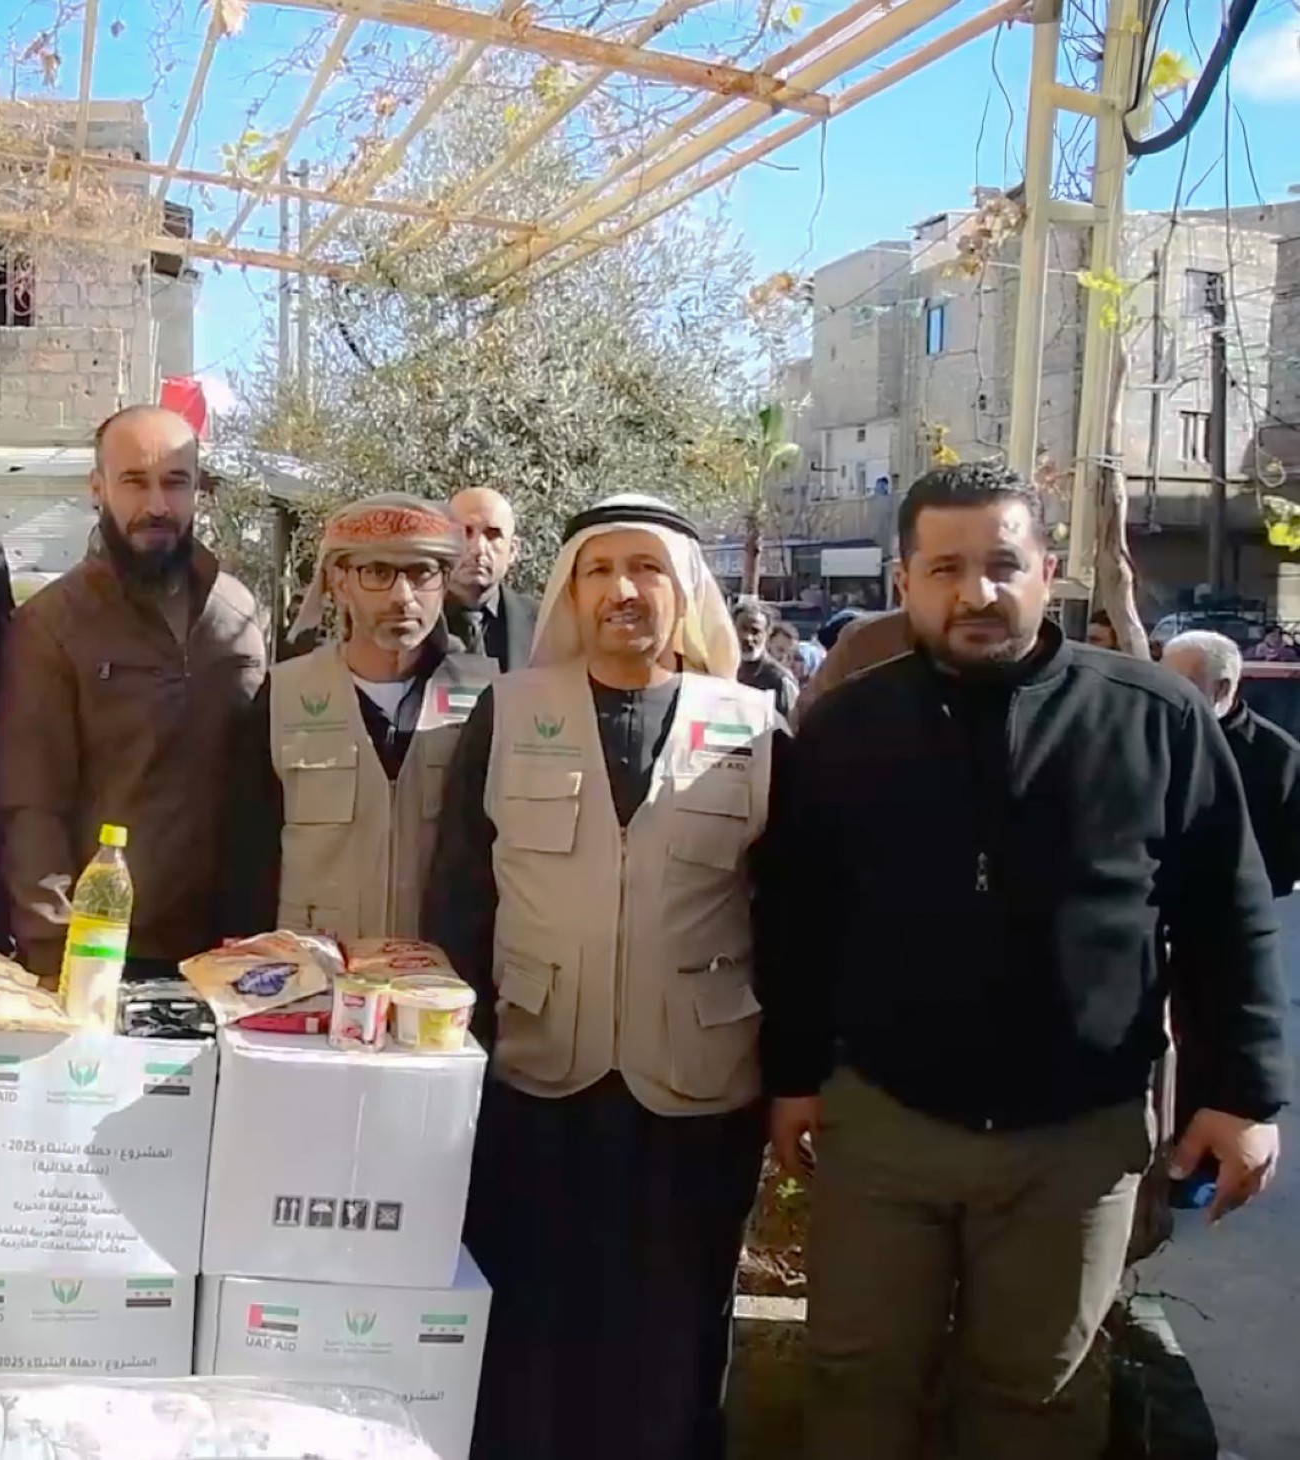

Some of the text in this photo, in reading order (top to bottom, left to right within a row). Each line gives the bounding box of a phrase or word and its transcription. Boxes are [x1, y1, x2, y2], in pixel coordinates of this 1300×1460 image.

[246, 1337, 297, 1352] UAE AID
[105, 1355, 157, 1371] المشروع
